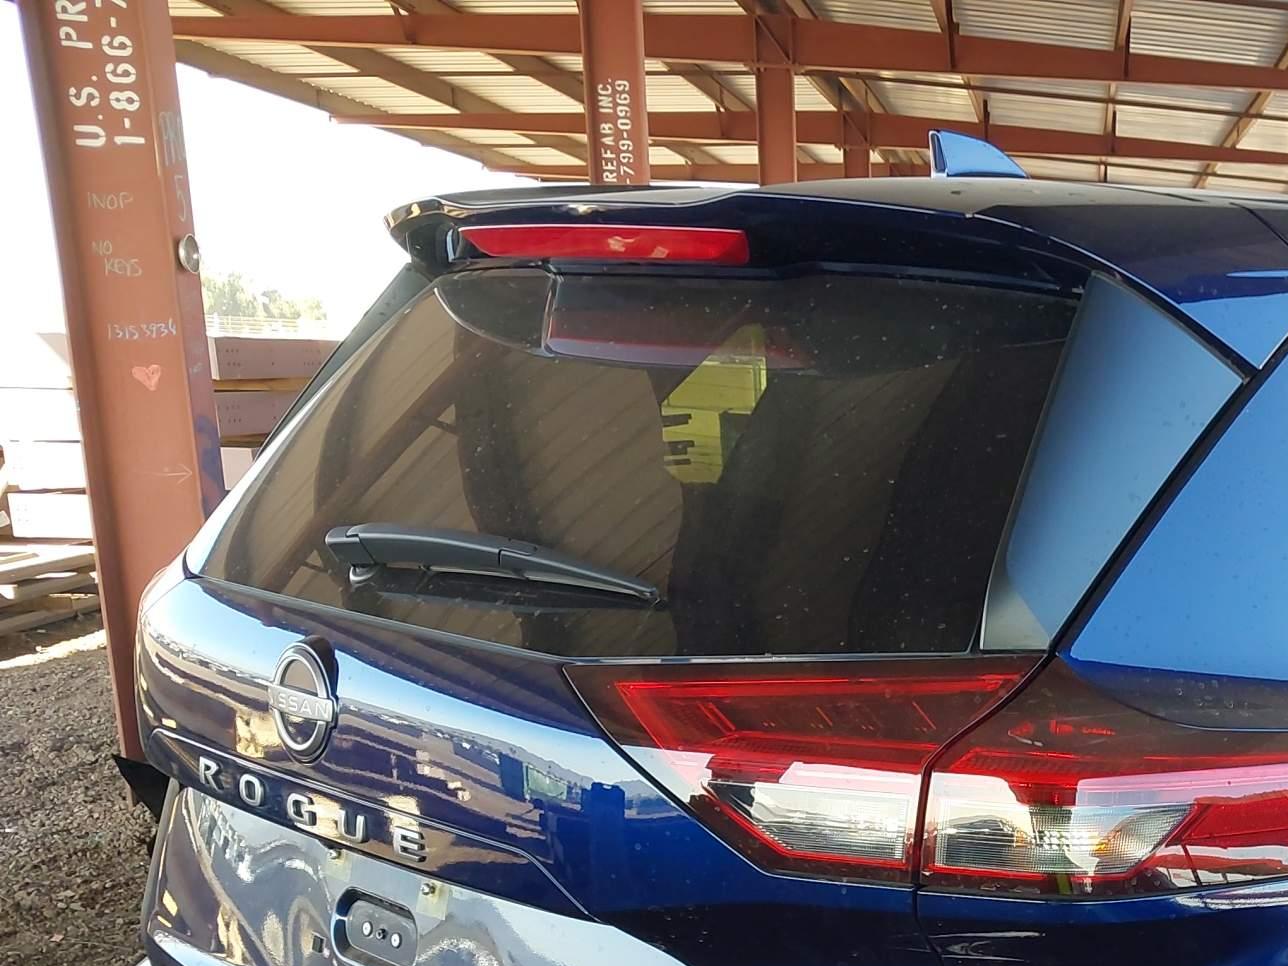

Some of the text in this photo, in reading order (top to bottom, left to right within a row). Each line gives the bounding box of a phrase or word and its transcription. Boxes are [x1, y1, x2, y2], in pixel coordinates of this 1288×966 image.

[68, 75, 106, 148] U.S.
[597, 78, 613, 113] INC.
[104, 258, 143, 276] KEYS
[270, 689, 329, 720] SSAN
[199, 755, 427, 863] ROGUE
